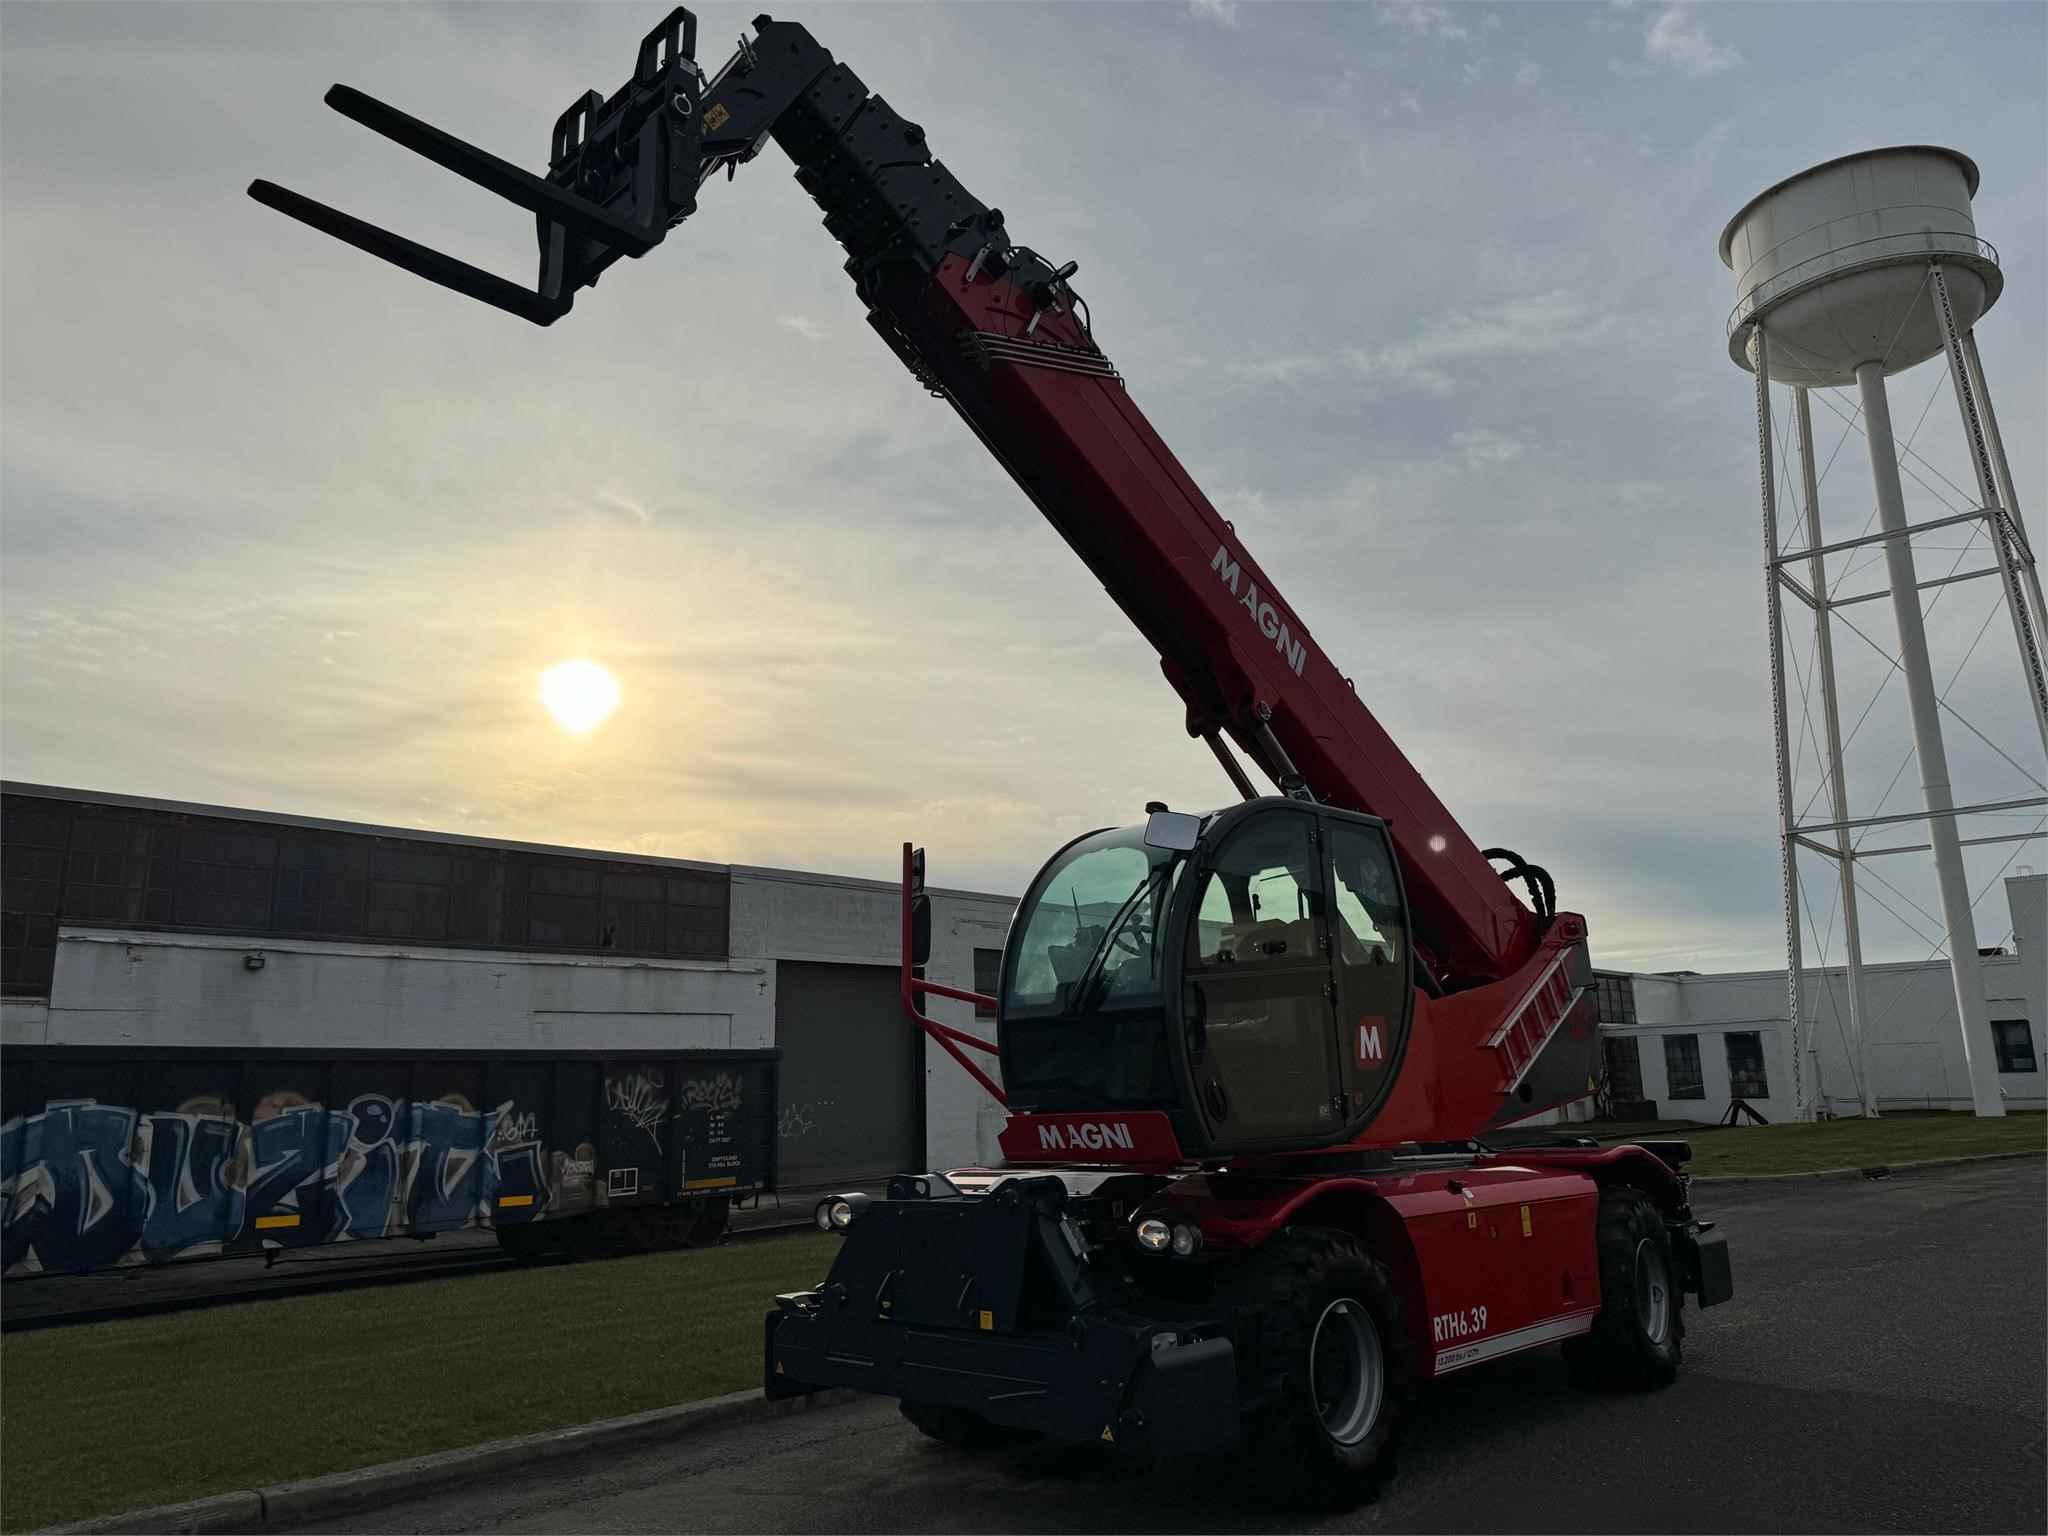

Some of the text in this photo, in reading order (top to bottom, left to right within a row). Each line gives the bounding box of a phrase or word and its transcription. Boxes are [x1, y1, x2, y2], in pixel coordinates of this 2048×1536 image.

[1210, 544, 1307, 677] MAGNI
[1360, 1025, 1382, 1059] M
[1037, 1122, 1135, 1149] MAGNI
[1433, 1305, 1487, 1342] RTH6.39
